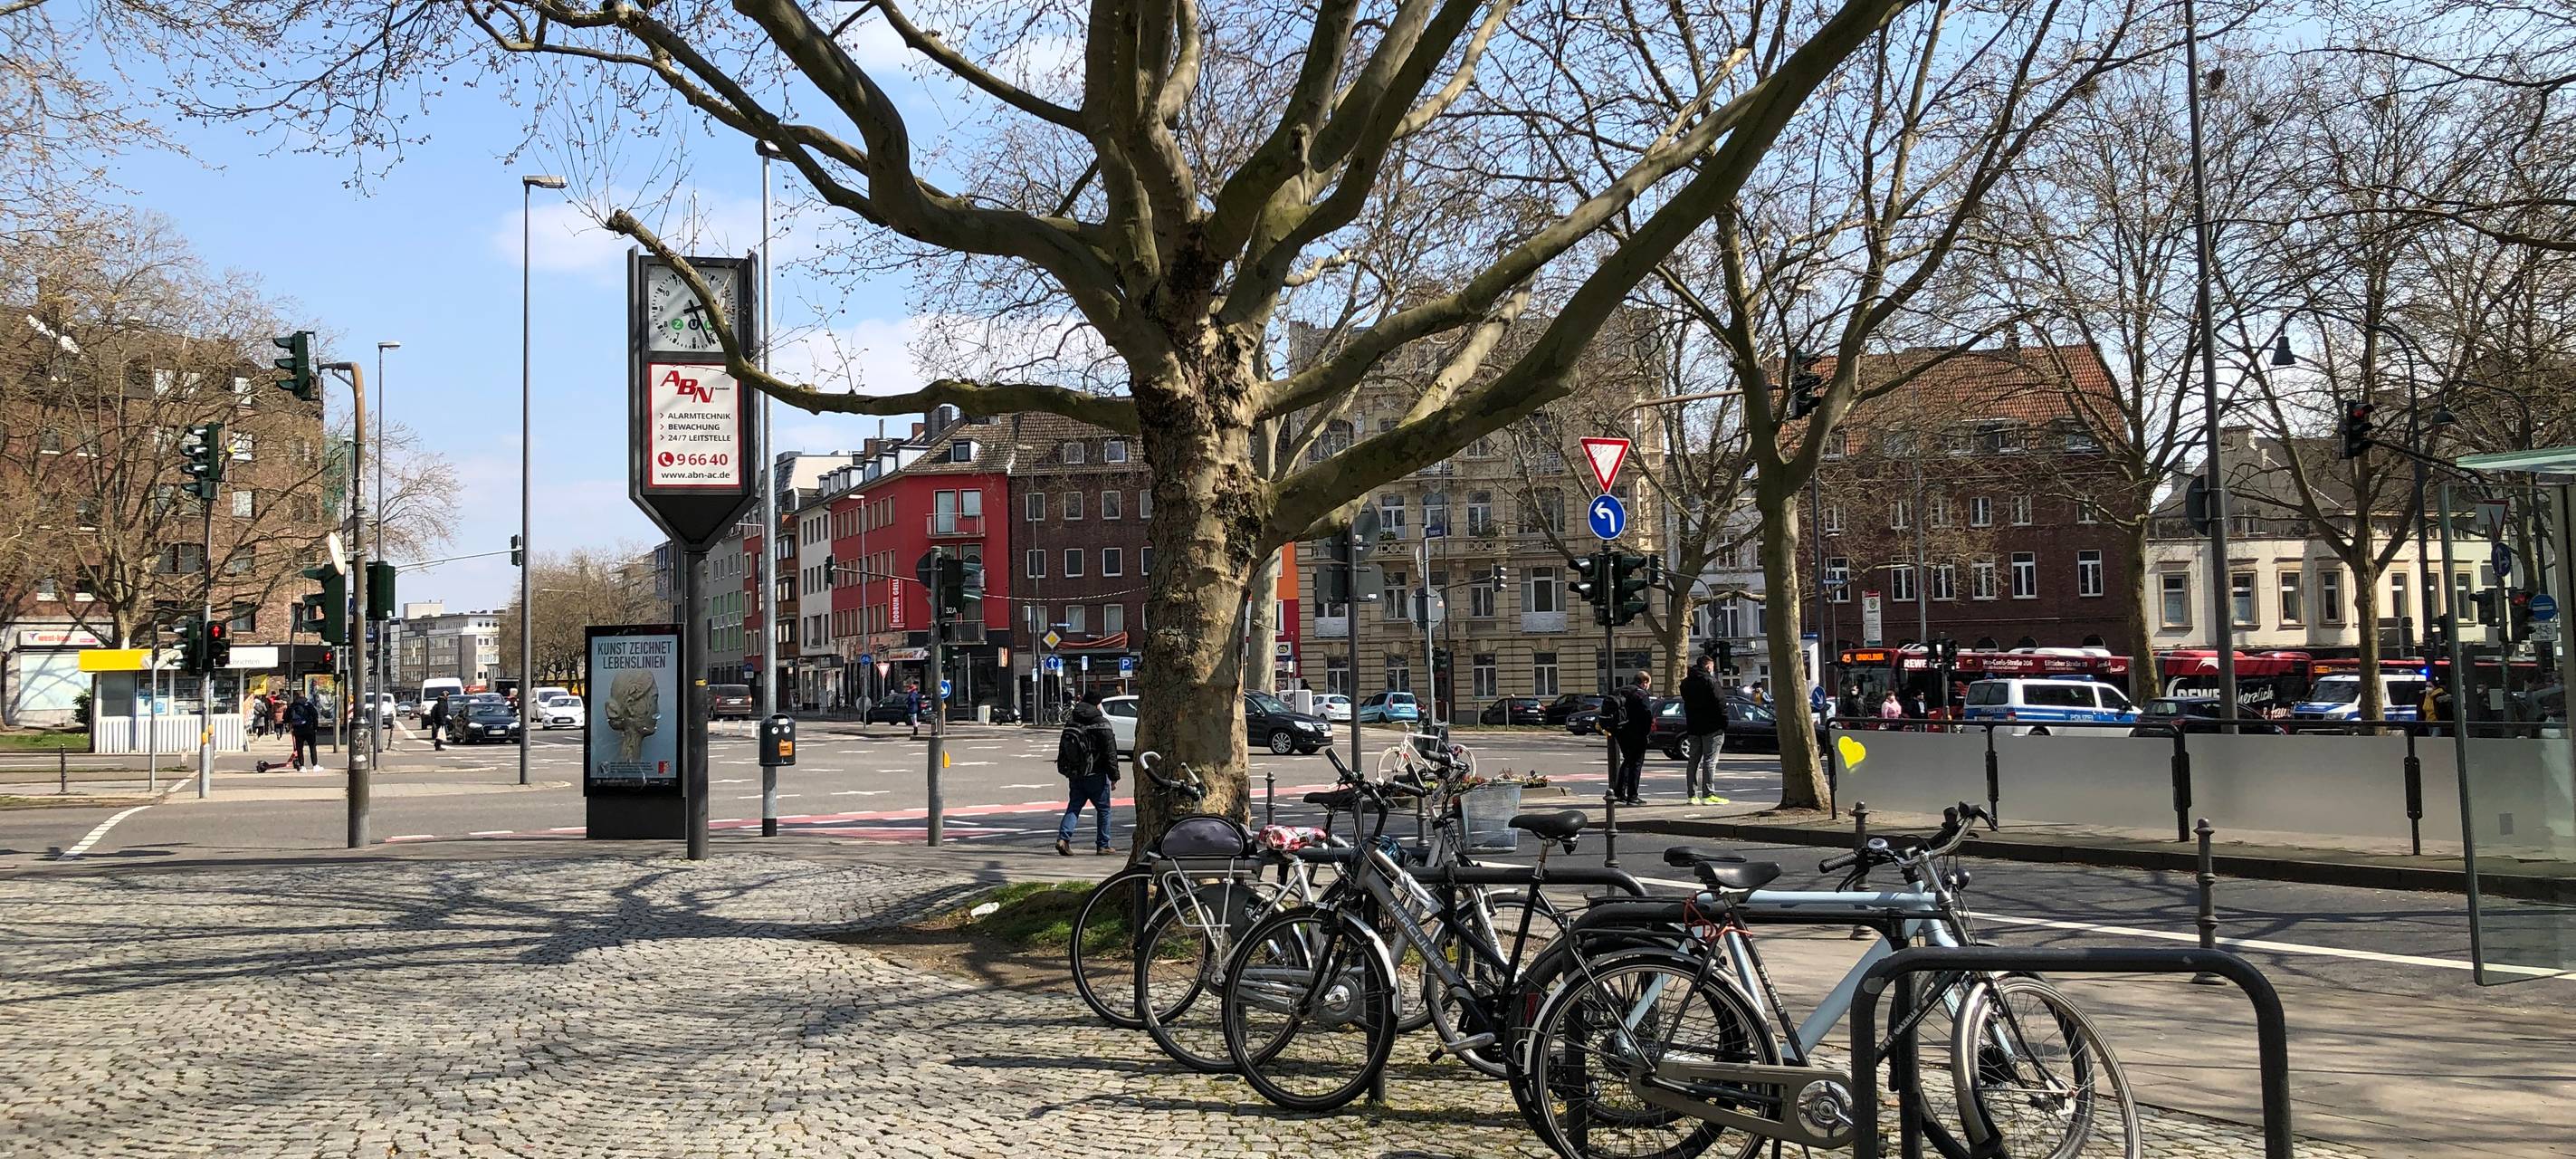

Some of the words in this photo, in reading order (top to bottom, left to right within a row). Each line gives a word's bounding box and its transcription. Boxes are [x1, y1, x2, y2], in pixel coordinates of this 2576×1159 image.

[660, 370, 714, 403] ABN
[597, 642, 626, 656] KUNST
[629, 640, 672, 655] ZEICHNET
[603, 656, 666, 669] LEBENSLINIEN
[1121, 659, 1130, 669] P
[1842, 654, 1852, 663] 45
[1903, 658, 1927, 668] REWE
[2069, 714, 2094, 722] POLIZEI
[1388, 900, 1445, 969] HERCULES
[1894, 1007, 1921, 1035] GAZELLE
